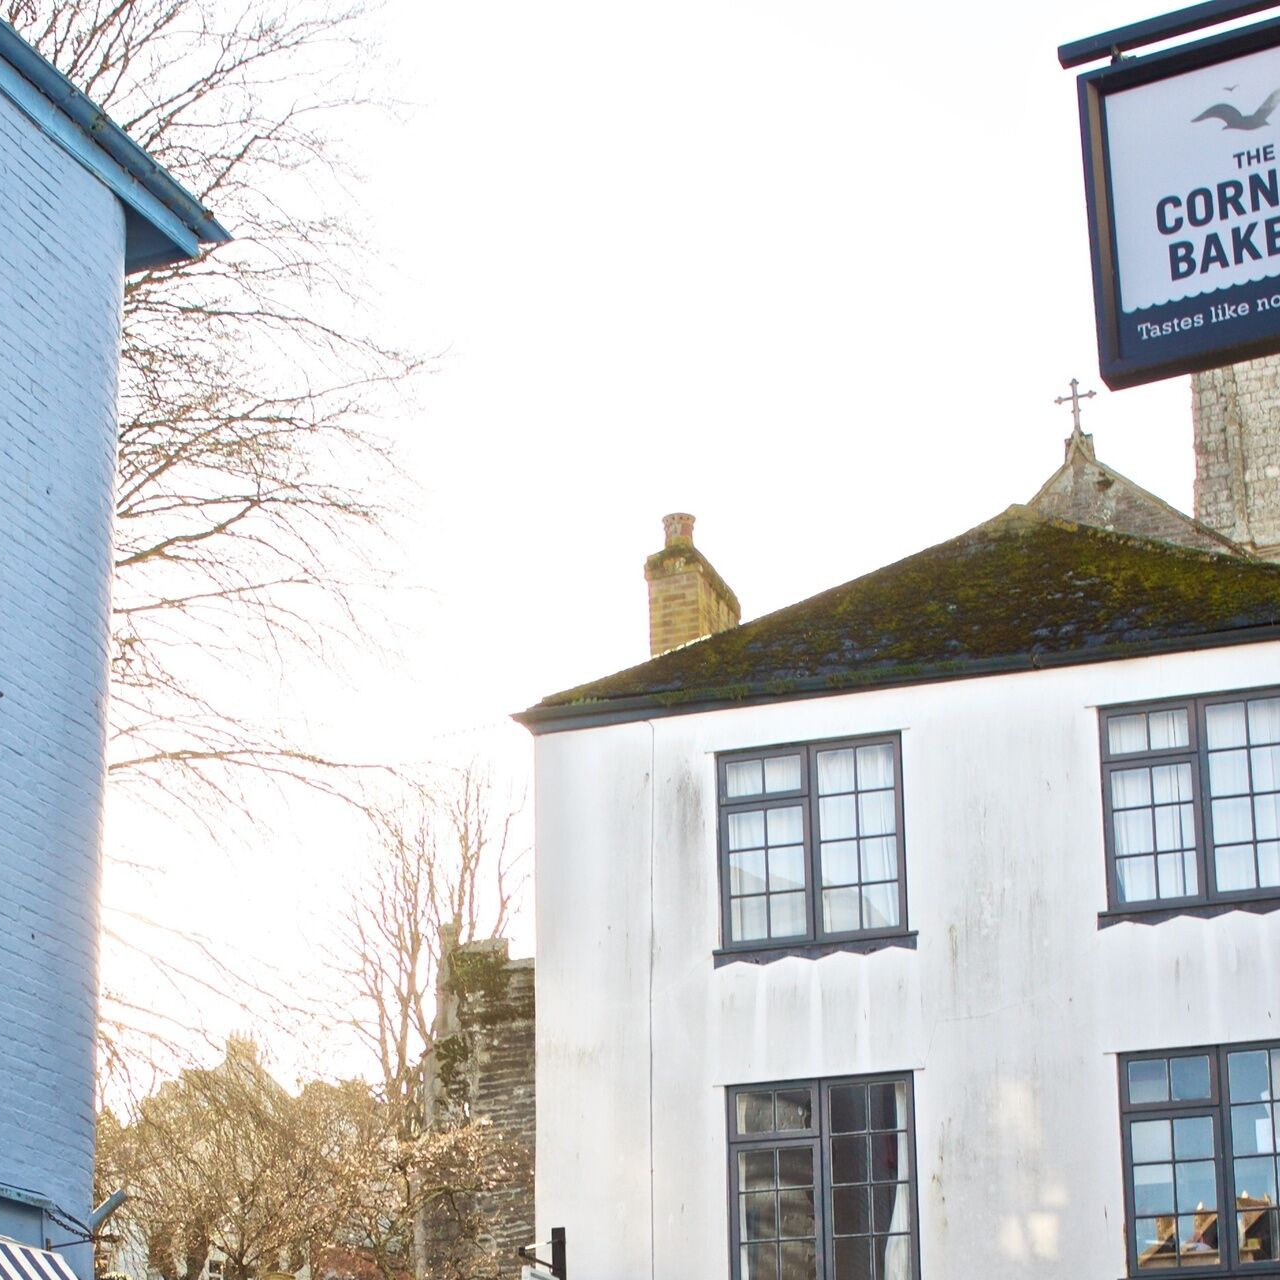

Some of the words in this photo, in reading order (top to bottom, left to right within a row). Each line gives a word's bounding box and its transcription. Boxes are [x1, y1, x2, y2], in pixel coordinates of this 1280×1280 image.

[1233, 143, 1276, 169] THE
[1138, 311, 1205, 341] Tastes
[1210, 296, 1250, 324] like
